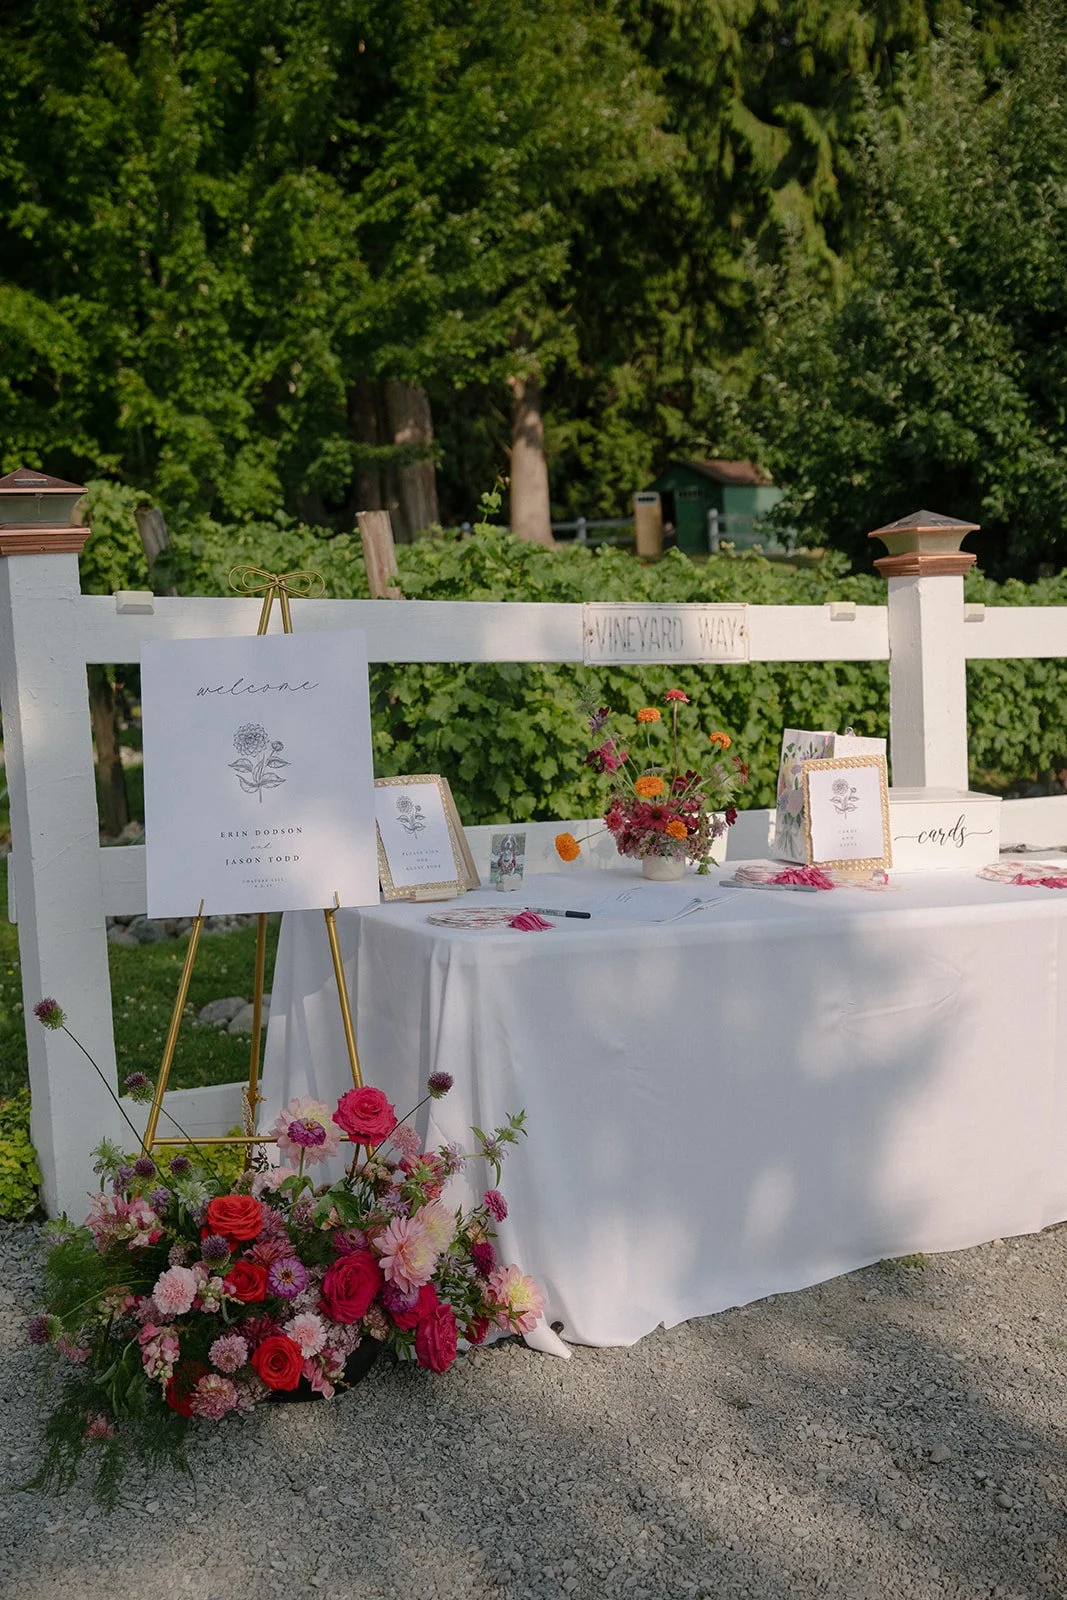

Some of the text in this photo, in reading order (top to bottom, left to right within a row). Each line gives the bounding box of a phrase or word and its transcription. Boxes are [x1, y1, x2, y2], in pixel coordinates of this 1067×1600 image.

[595, 616, 738, 652] VINEYARD WAY
[196, 678, 320, 697] welcome
[220, 827, 303, 838] ERIN DODSON
[894, 814, 993, 848] cards
[225, 855, 300, 866] JASON TODD
